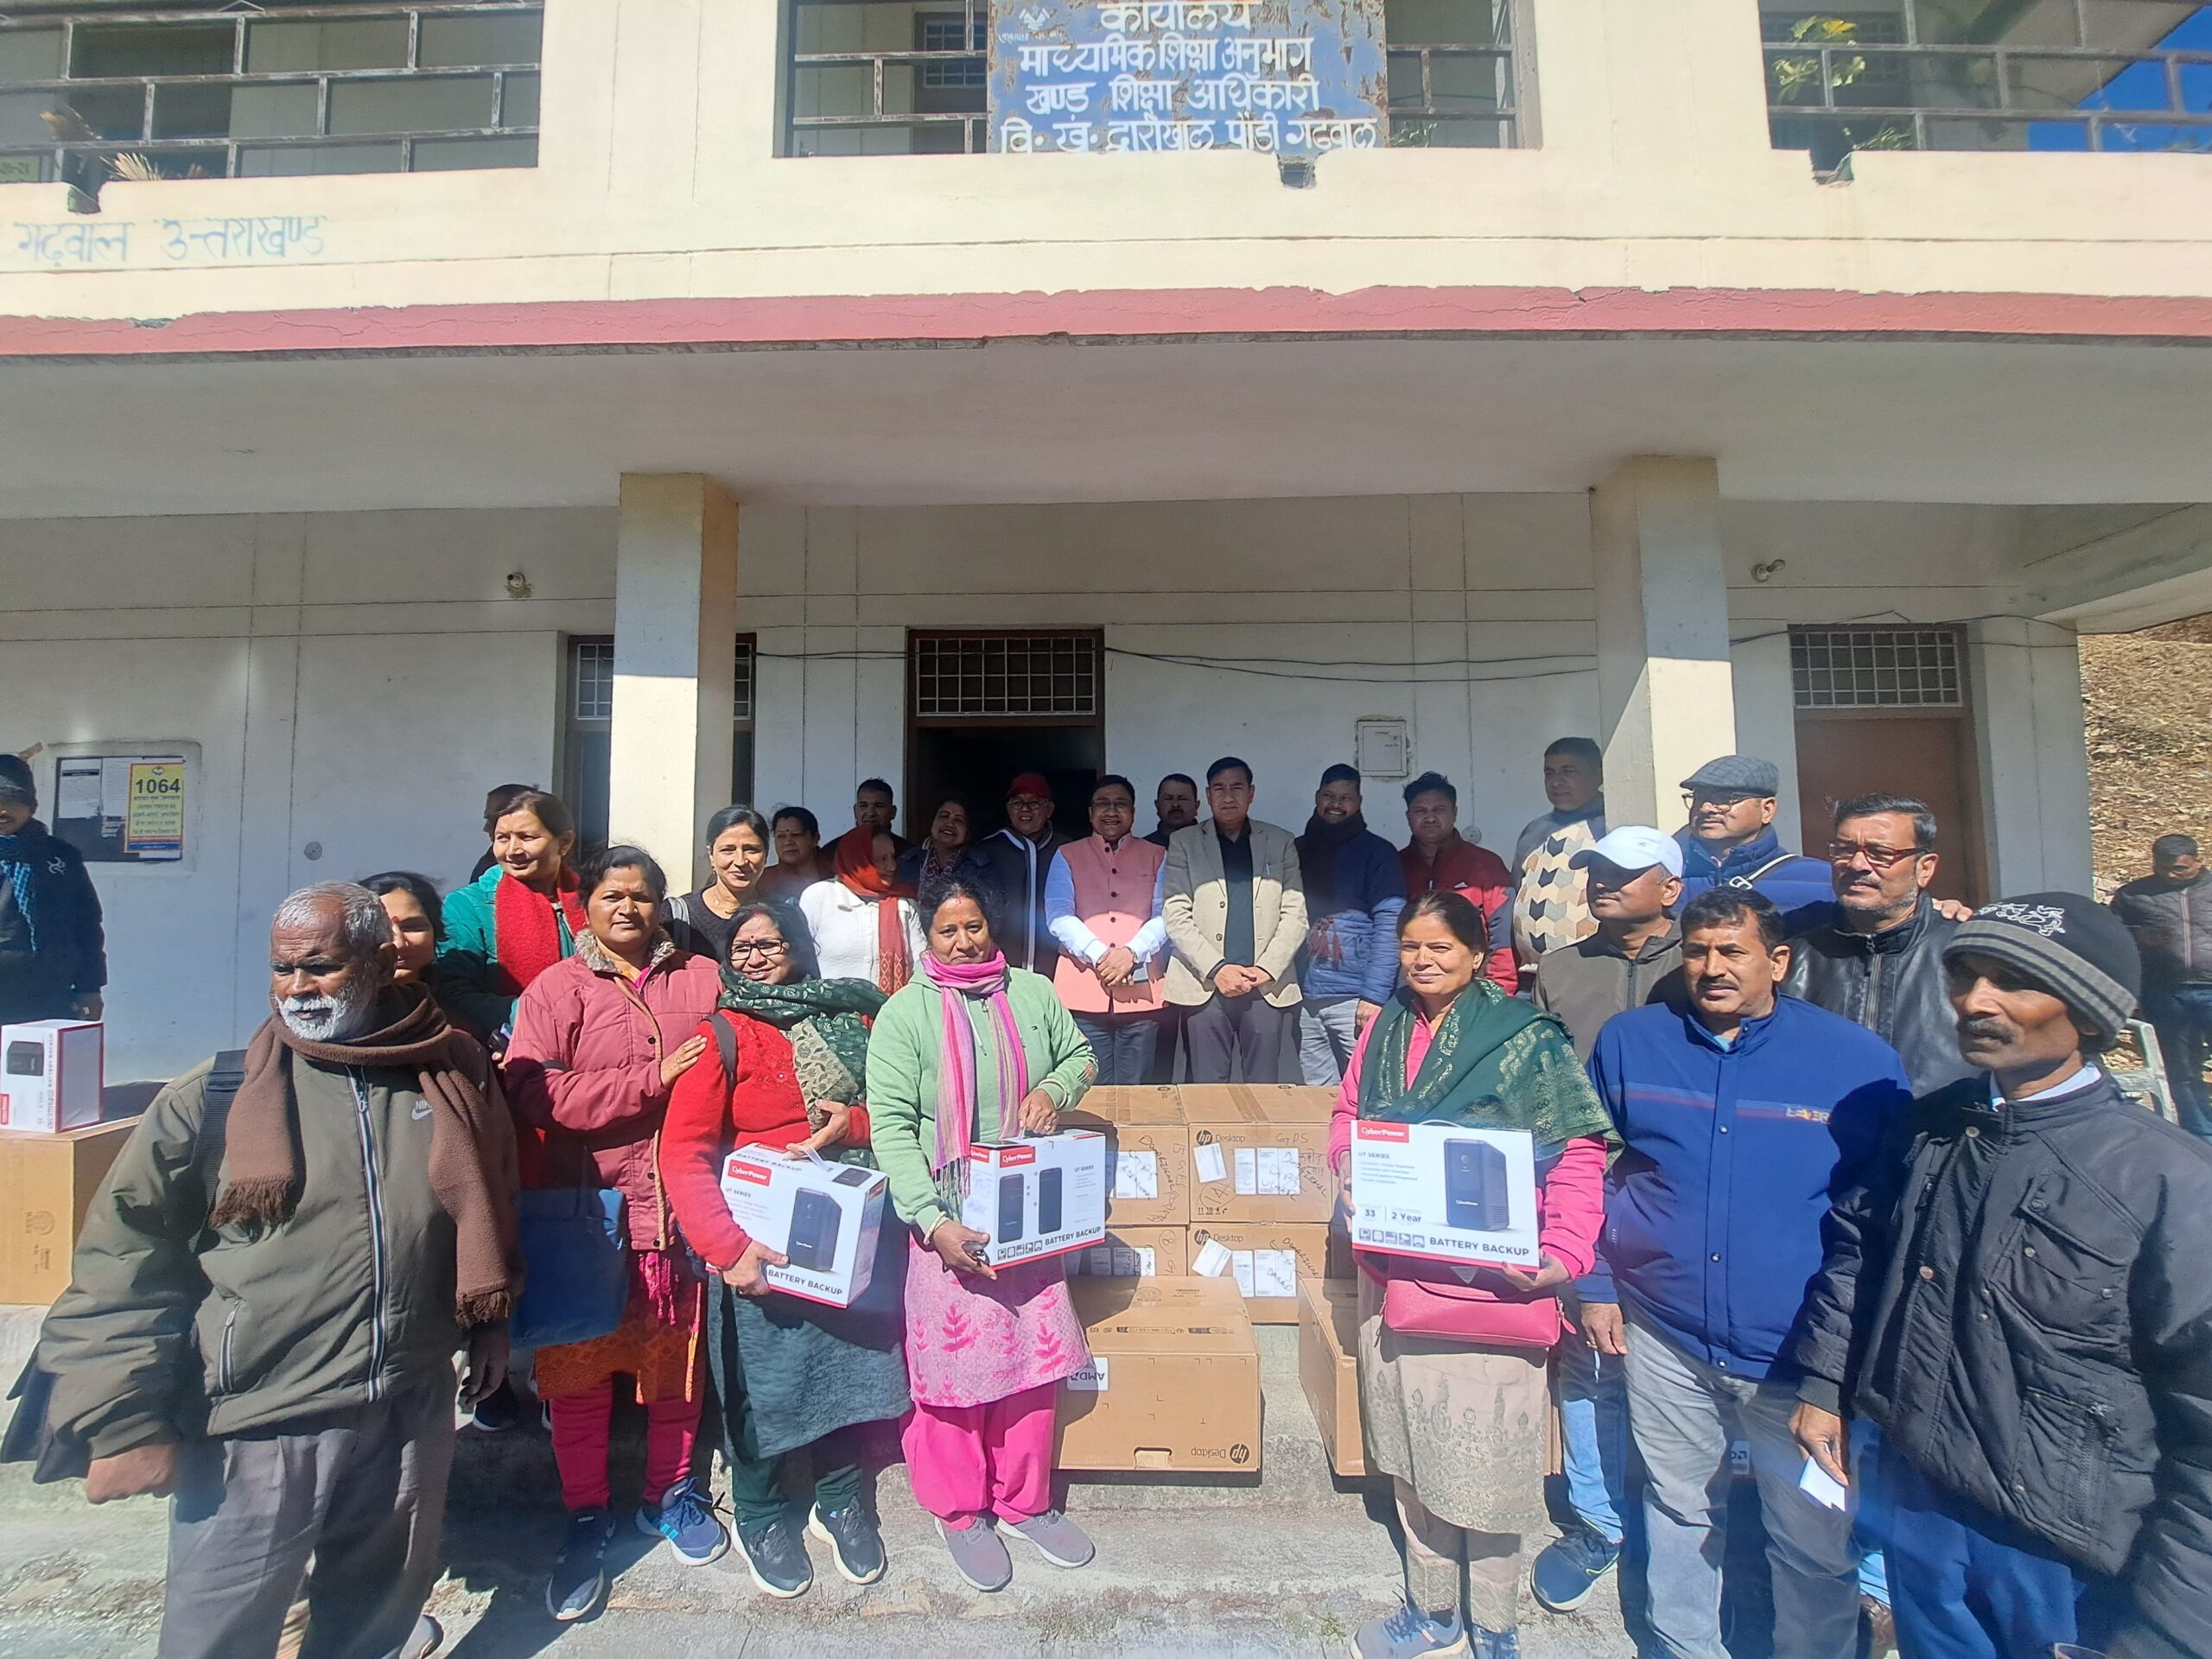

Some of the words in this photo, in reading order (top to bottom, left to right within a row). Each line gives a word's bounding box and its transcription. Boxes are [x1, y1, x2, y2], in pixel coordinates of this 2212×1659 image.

[1159, 32, 1218, 73] शिक्षा
[1026, 82, 1096, 114] खण्ड
[1109, 74, 1179, 114] शिक्षा
[1186, 73, 1319, 111] अधिकारी
[136, 779, 181, 794] 1064
[1198, 1130, 1212, 1145] hp
[1216, 1134, 1245, 1142] Desktop
[1361, 1128, 1405, 1137] CyberPower
[1002, 1154, 1033, 1163] CyberPower
[732, 1166, 768, 1180] CyberPower
[734, 1189, 751, 1198] SERIES
[1364, 1209, 1376, 1217] 33
[1391, 1211, 1397, 1220] 2
[1400, 1213, 1421, 1223] Year
[1045, 1232, 1074, 1246] BATTERY
[1076, 1226, 1102, 1238] BACKUP
[1213, 1234, 1243, 1243] Desktop
[1430, 1236, 1478, 1250] BATTERY
[1483, 1243, 1529, 1256] BACKUP
[768, 1268, 806, 1286] BATTERY
[808, 1280, 842, 1296] BACKUP
[1191, 1446, 1226, 1459] Desktop
[1231, 1444, 1249, 1464] hp
